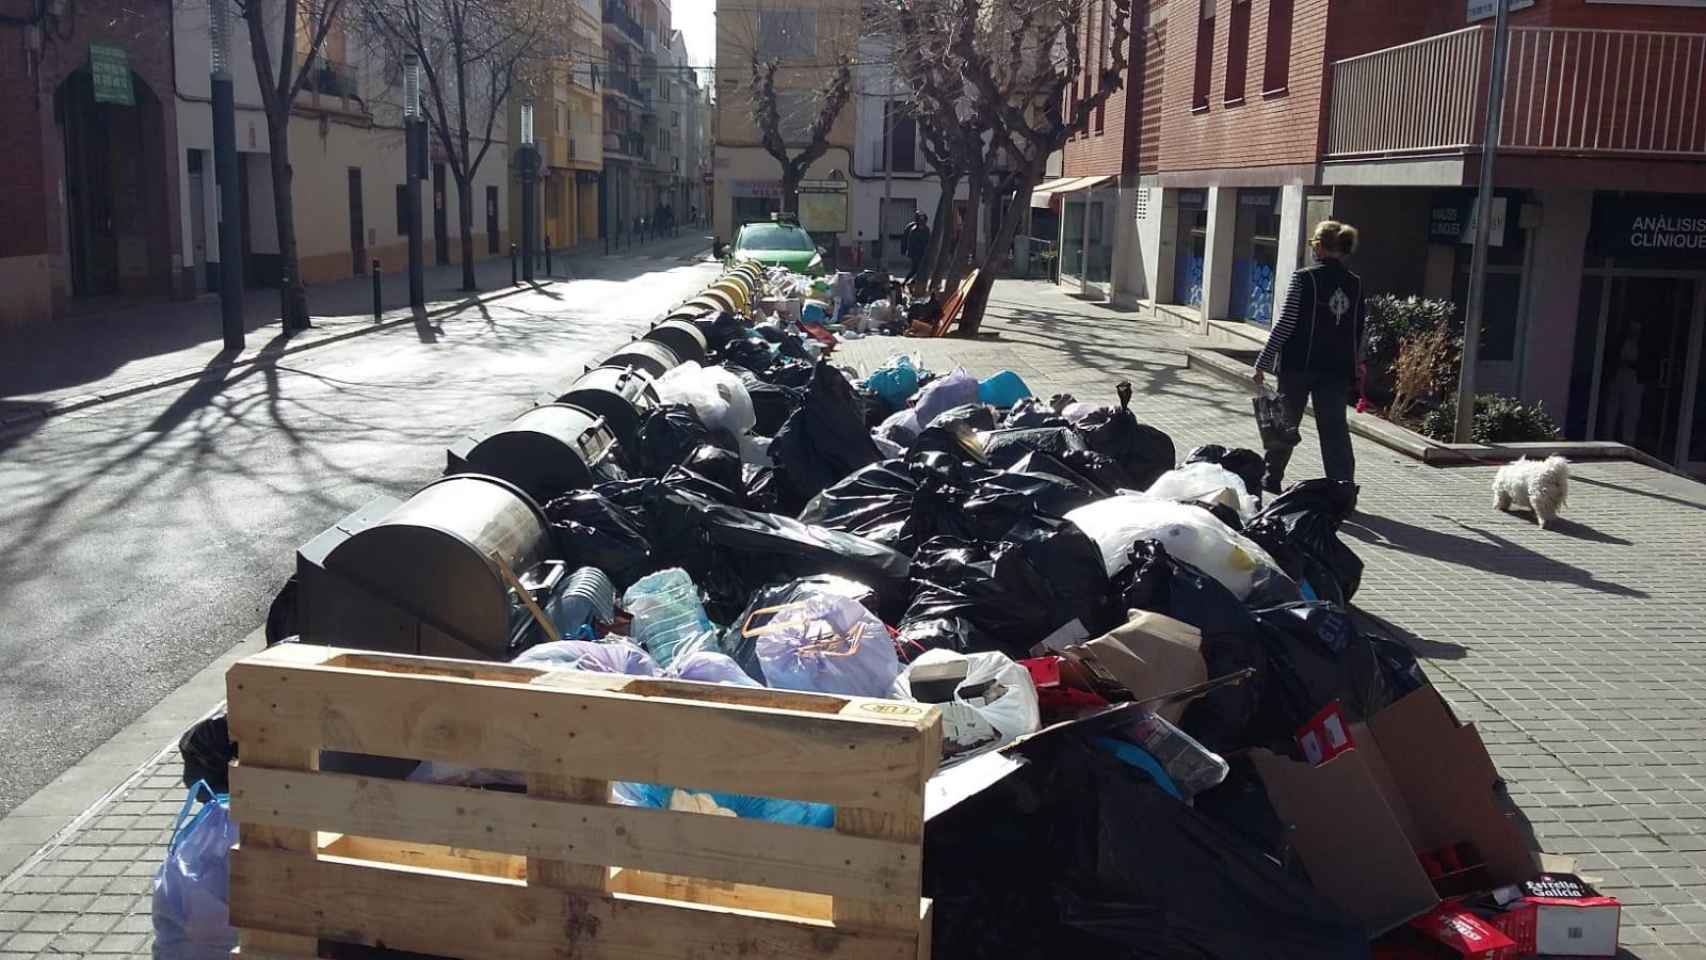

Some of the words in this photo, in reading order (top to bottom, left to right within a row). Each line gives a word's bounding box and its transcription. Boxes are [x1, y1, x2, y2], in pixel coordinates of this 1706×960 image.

[1632, 213, 1706, 232] ANÀLISIS
[1526, 880, 1578, 889] Estrella
[1532, 887, 1582, 897] Galicia
